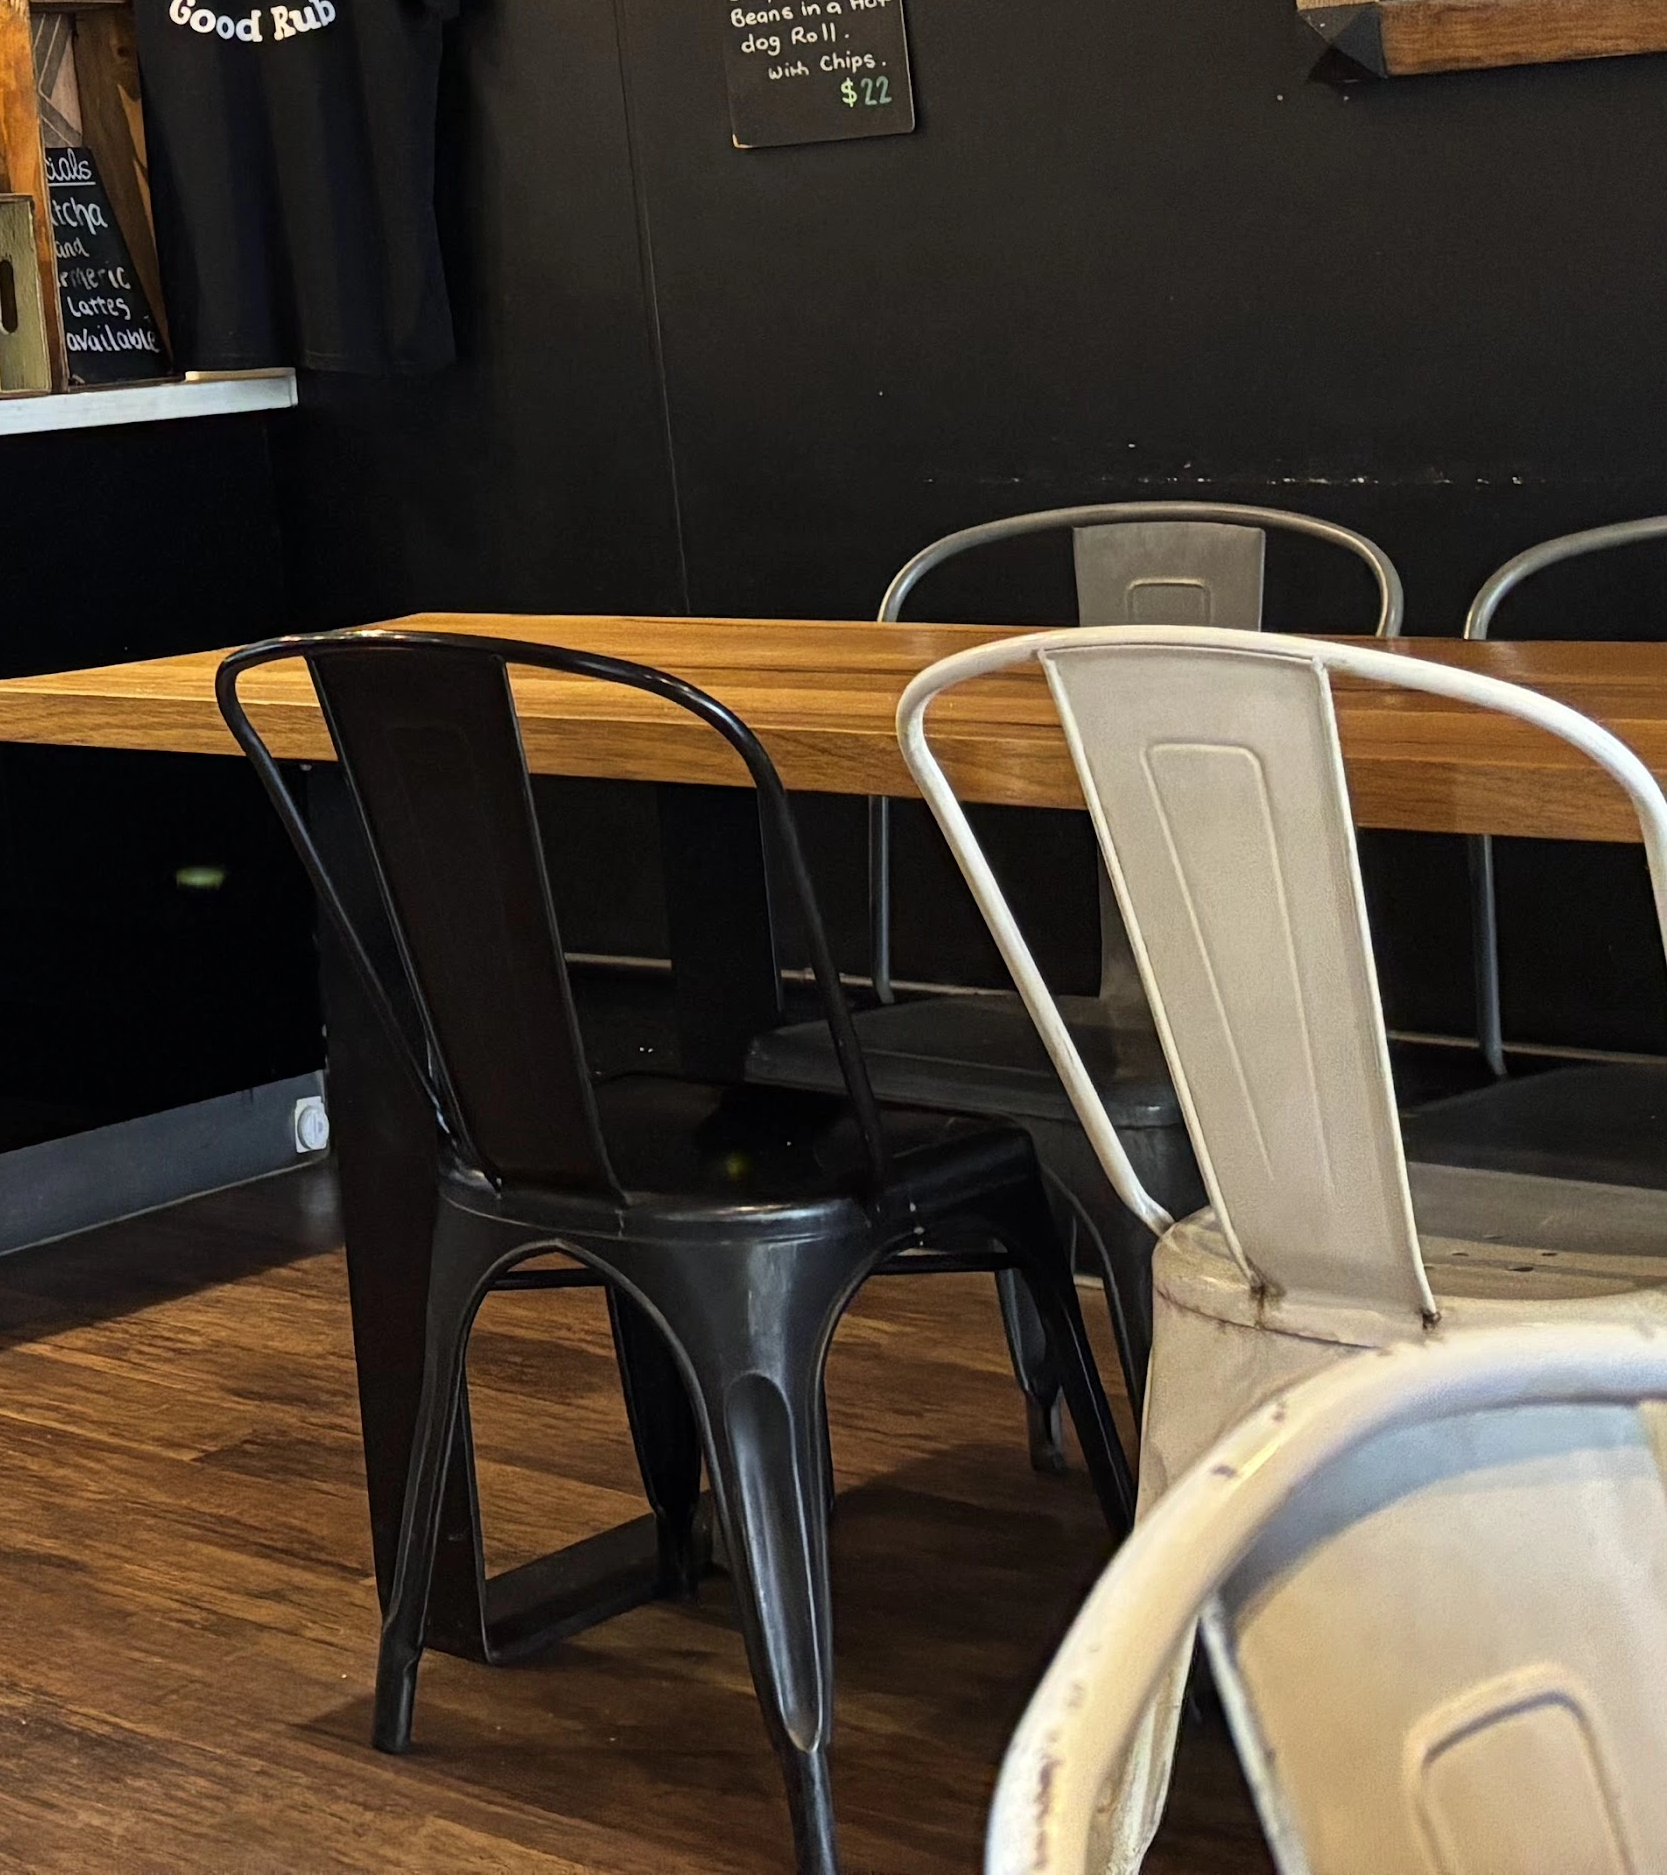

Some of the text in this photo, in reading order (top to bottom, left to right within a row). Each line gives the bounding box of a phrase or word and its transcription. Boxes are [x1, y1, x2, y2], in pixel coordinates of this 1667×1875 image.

[730, 7, 794, 28] Beans
[801, 1, 821, 16] in
[826, 1, 842, 15] a
[740, 33, 782, 56] dog
[840, 75, 893, 108] $22
[51, 196, 109, 236] tcha
[55, 237, 90, 259] and
[66, 324, 161, 354] available
